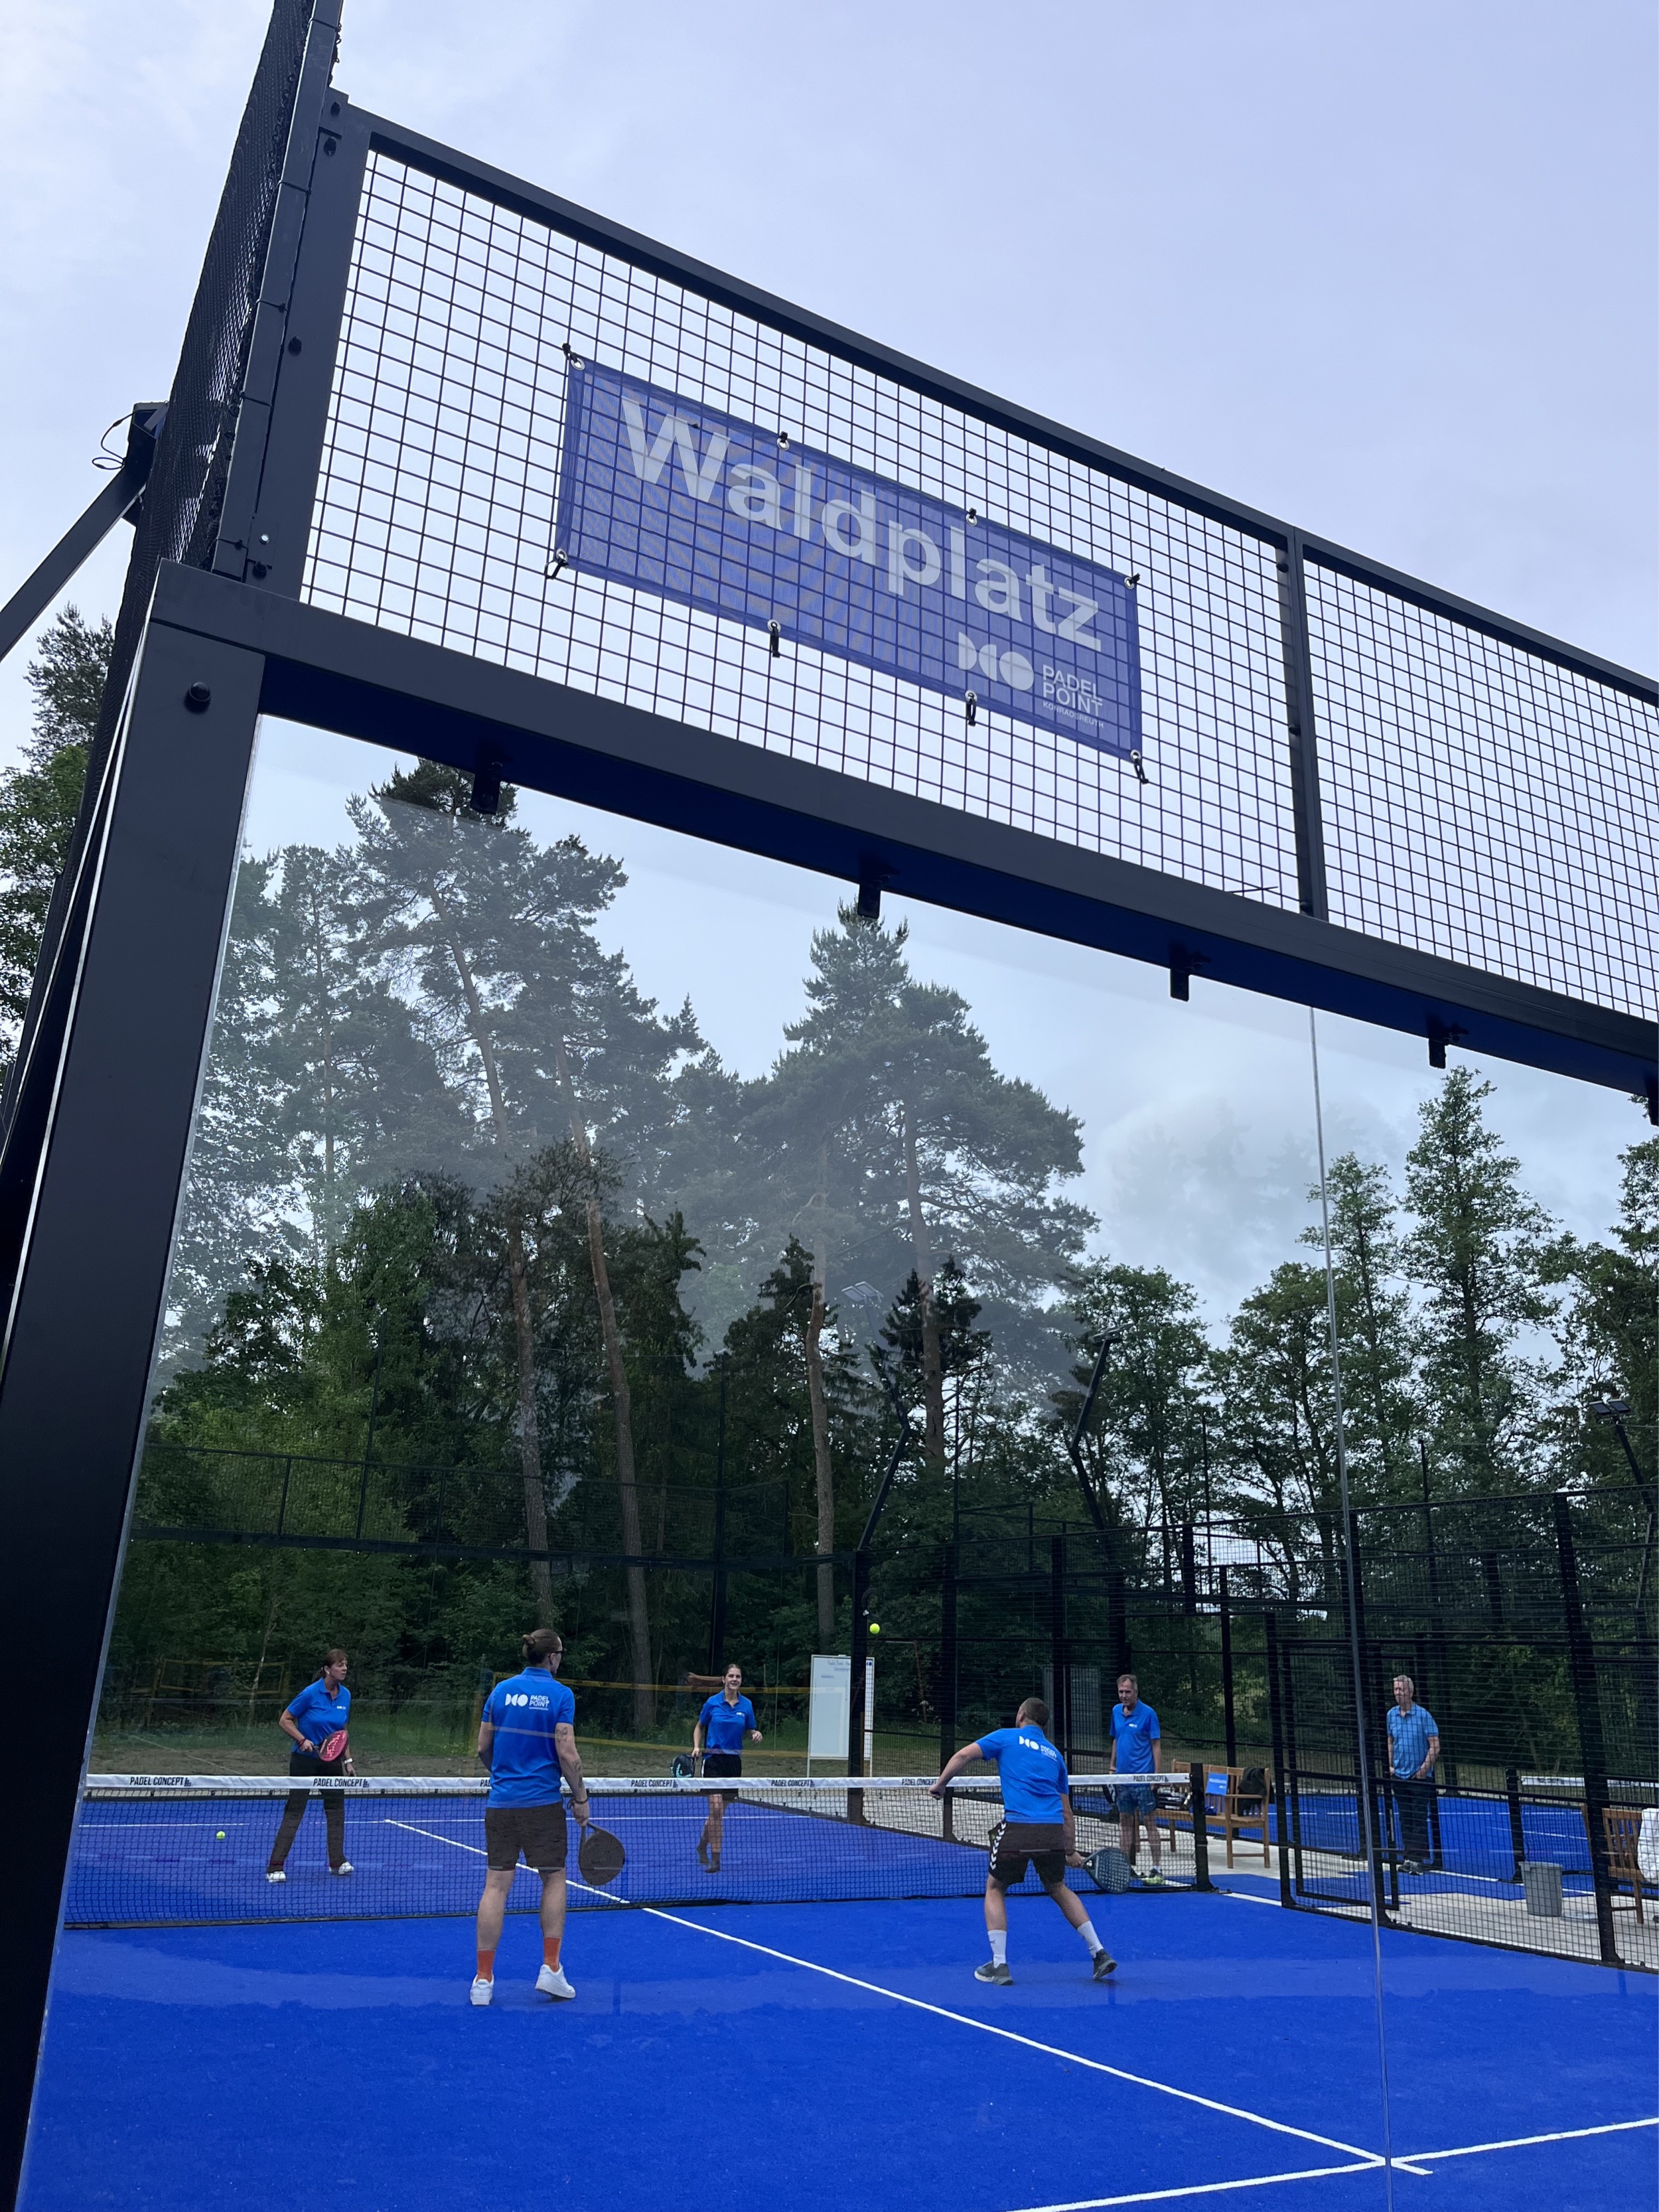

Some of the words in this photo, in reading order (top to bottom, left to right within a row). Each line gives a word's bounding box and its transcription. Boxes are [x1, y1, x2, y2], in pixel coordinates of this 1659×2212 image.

[619, 395, 1102, 652] Waldplatz
[1043, 664, 1102, 701] PADEL
[1043, 682, 1102, 717] POINT
[1043, 701, 1104, 729] KONRADSREUTH
[129, 1777, 151, 1785] PADEL
[153, 1777, 184, 1785] CONCEPT
[313, 1778, 332, 1787] PADEL
[334, 1778, 364, 1787] CONCEPT
